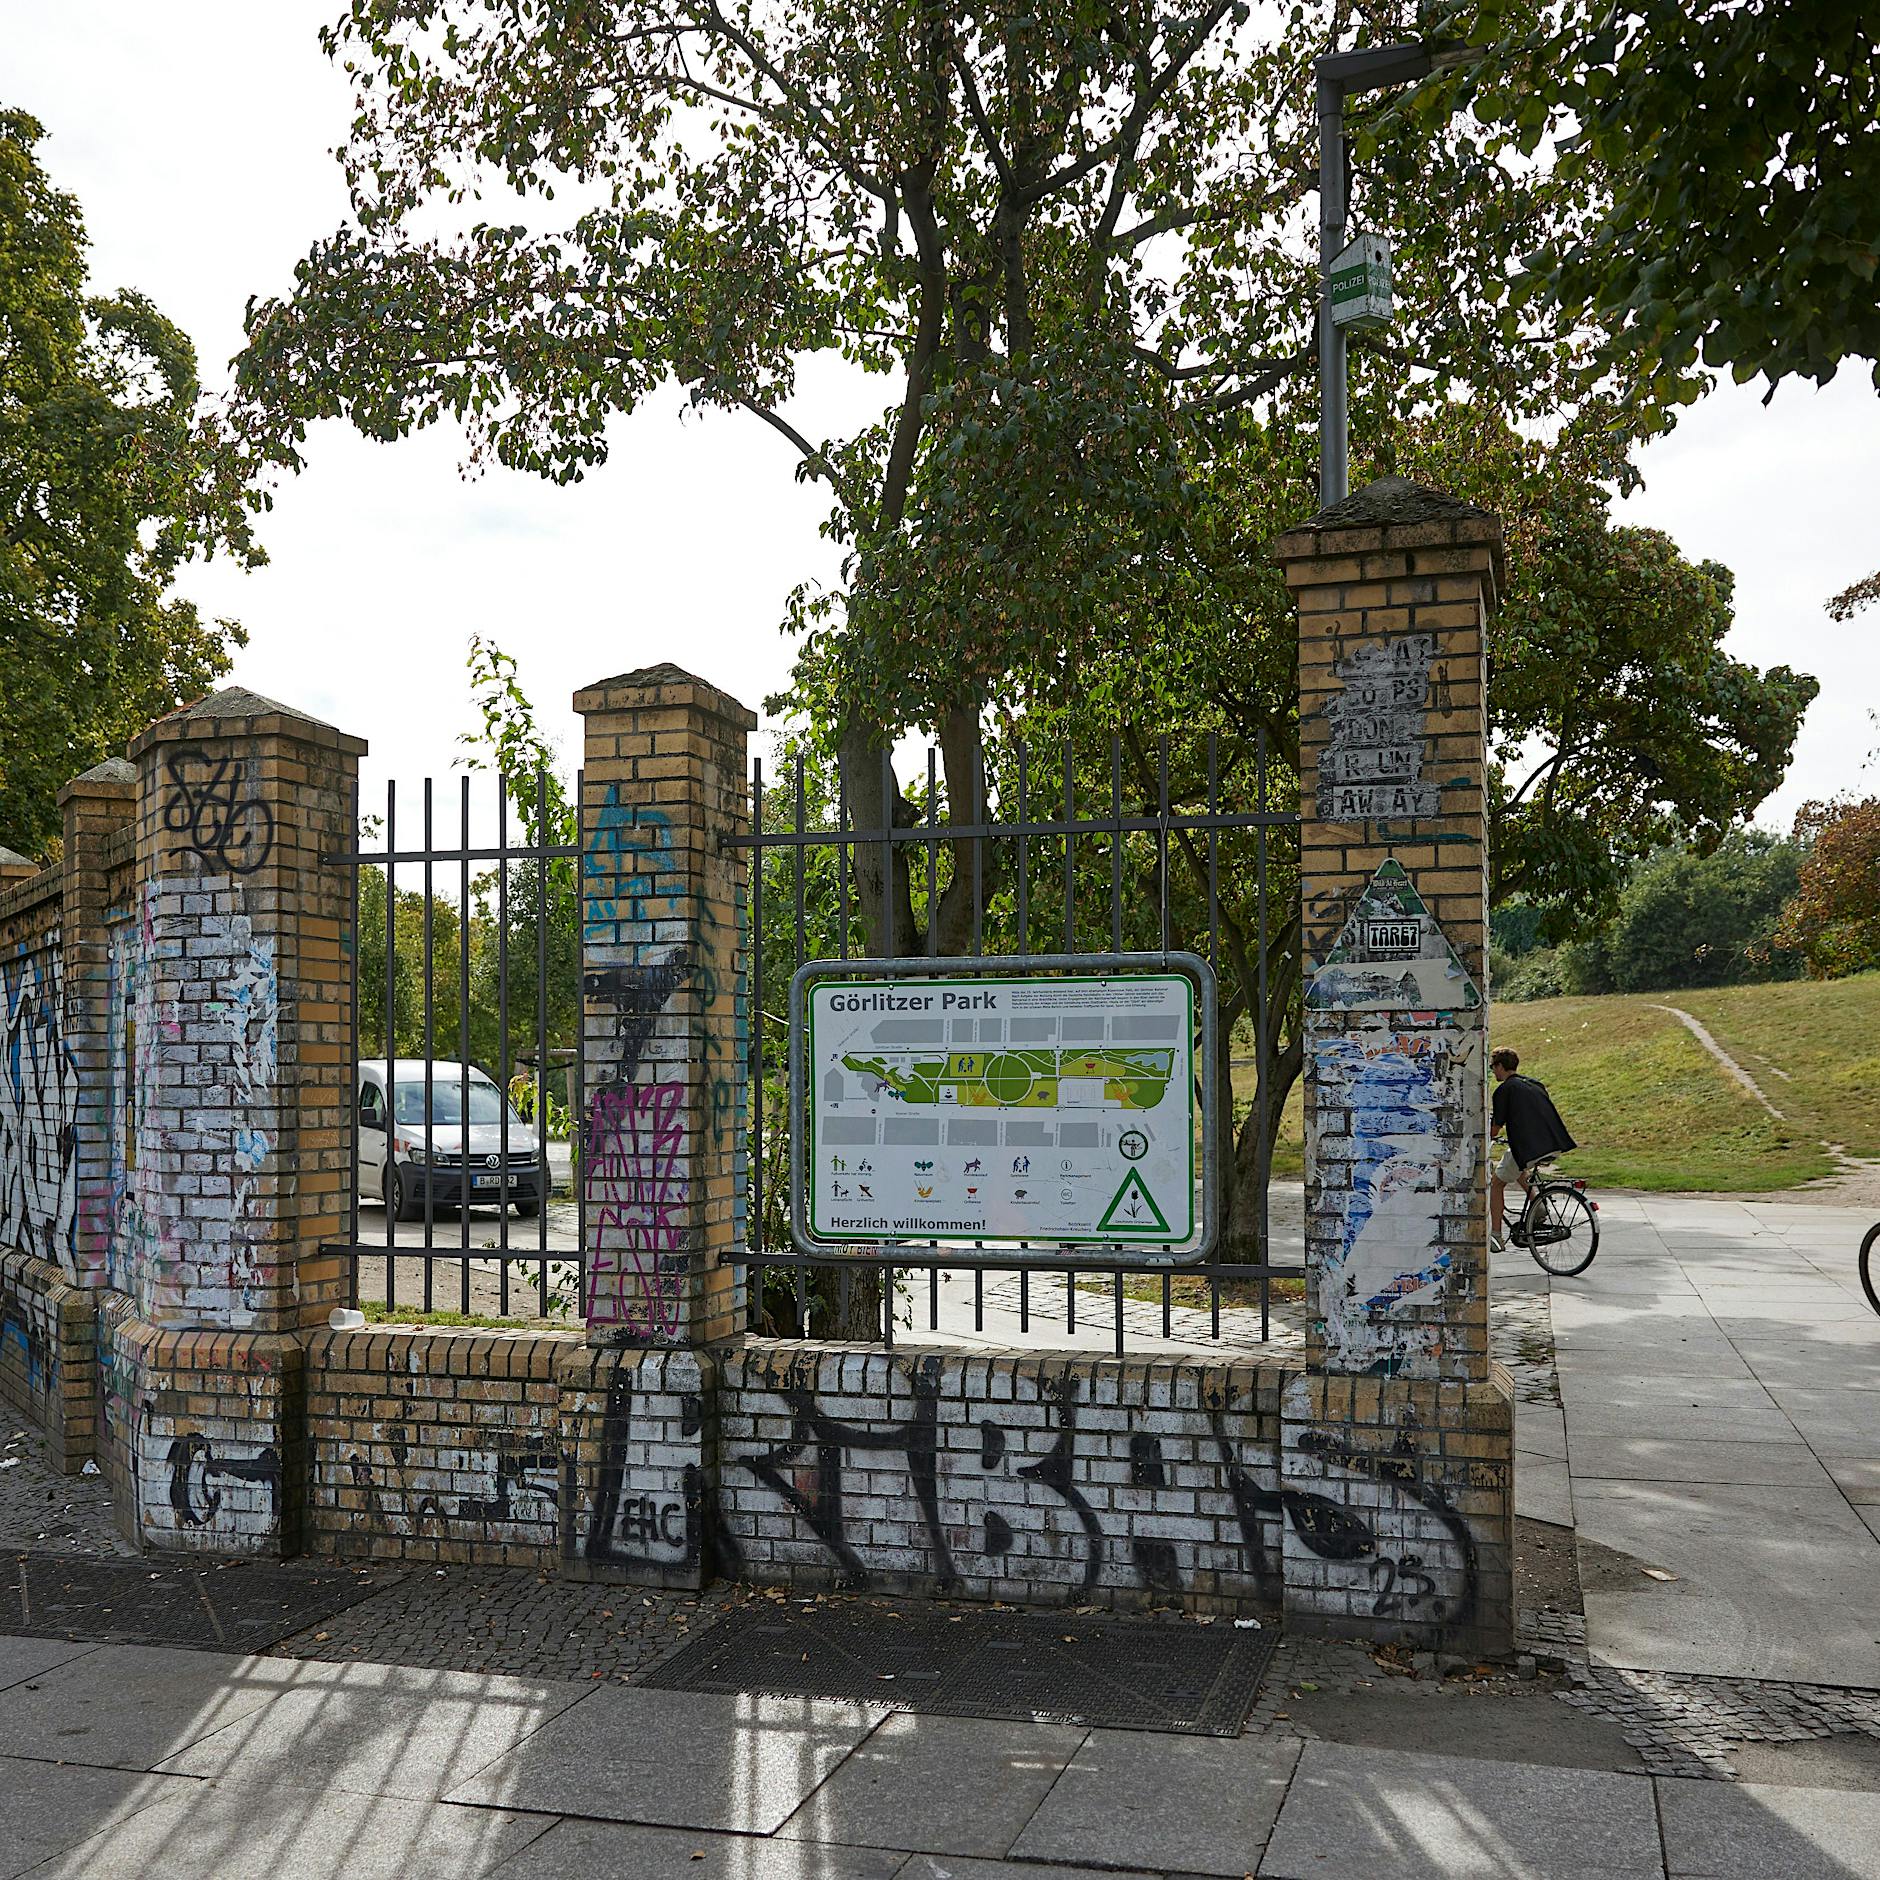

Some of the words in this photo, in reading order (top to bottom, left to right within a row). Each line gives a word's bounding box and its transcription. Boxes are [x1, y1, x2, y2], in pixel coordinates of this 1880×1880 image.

[1332, 274, 1365, 294] POLIZEI
[1368, 275, 1391, 290] POLIZEI
[1341, 787, 1424, 815] AWAY
[829, 993, 934, 1012] Görlitzer
[942, 991, 998, 1010] Park
[831, 1216, 888, 1229] Herzlich
[893, 1217, 986, 1230] willkommen!
